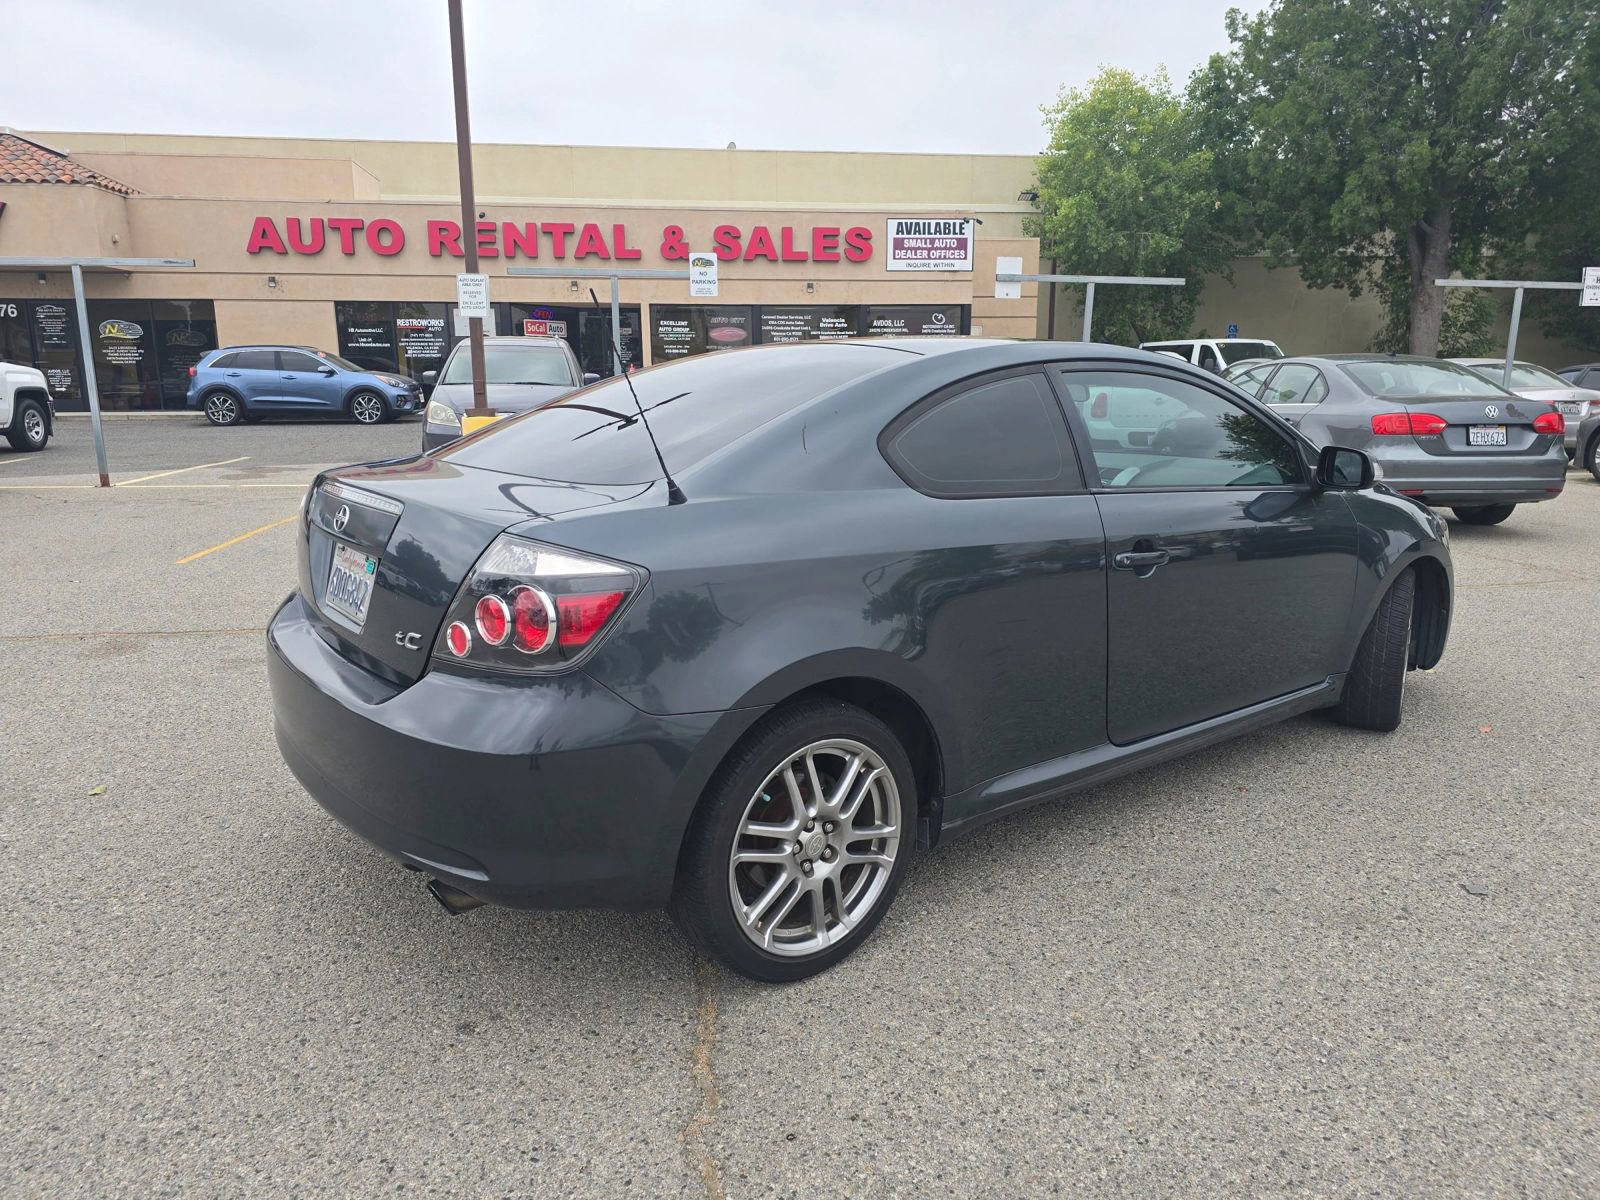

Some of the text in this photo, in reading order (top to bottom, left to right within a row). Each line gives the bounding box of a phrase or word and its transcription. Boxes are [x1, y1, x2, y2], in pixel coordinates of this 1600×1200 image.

[895, 221, 966, 236] AVAILABLE
[246, 216, 874, 263] AUTO RENTAL & SALES
[903, 239, 957, 248] SMALL AUTO
[895, 250, 965, 259] DEALER OFFICES
[0, 303, 17, 317] 76
[396, 319, 444, 327] RESTROWORKS
[527, 323, 545, 332] SoCal
[395, 630, 423, 651] tC
